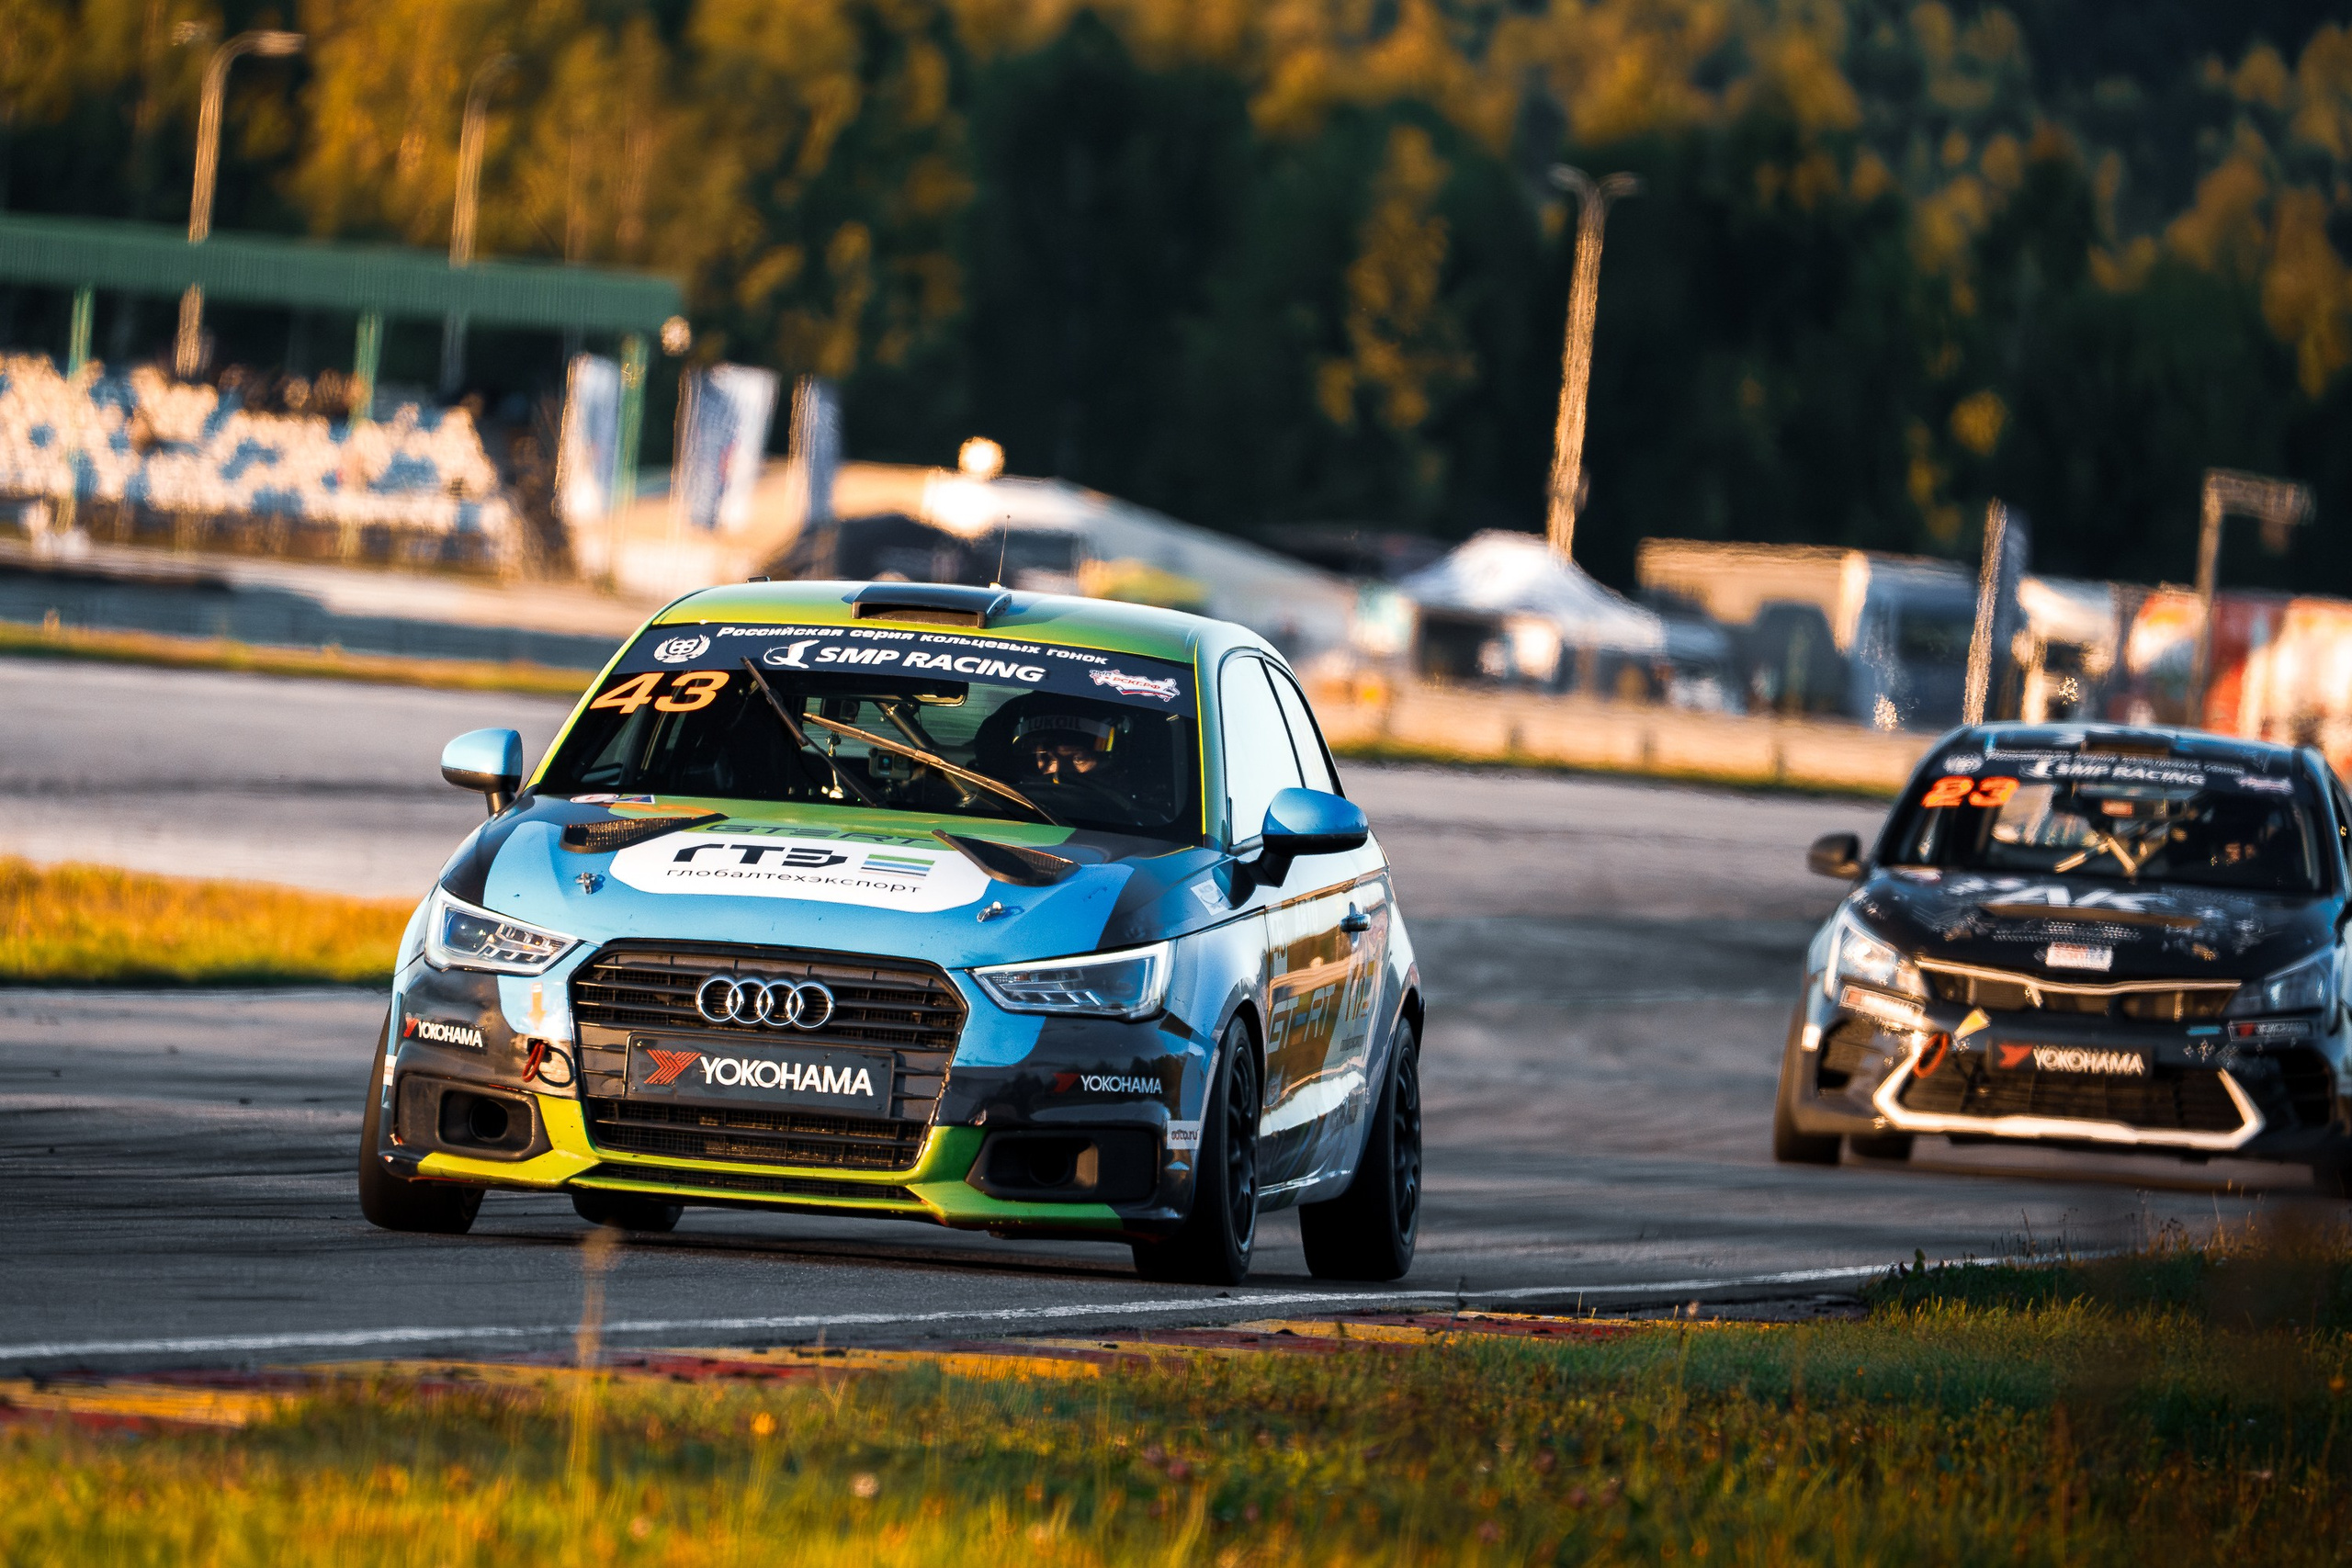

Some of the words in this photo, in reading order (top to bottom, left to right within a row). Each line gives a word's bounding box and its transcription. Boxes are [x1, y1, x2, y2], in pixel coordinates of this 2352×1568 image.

[717, 626, 844, 638] Российская
[849, 628, 915, 641] серия
[920, 633, 1041, 654] кольцевых
[1046, 648, 1109, 666] гонок
[815, 647, 900, 666] SMP
[902, 651, 1046, 683] RACING
[589, 671, 729, 714] 43
[2054, 763, 2110, 777] SMP
[2112, 766, 2205, 785] RACING
[1920, 775, 2020, 808] 23
[666, 869, 922, 894] глобалтехэкспорт
[418, 1021, 483, 1048] YOKOHAMA
[2032, 1044, 2143, 1076] YOKOHAMA
[699, 1056, 874, 1097] YOKOHAMA
[1080, 1074, 1163, 1095] YOKOHAMA
